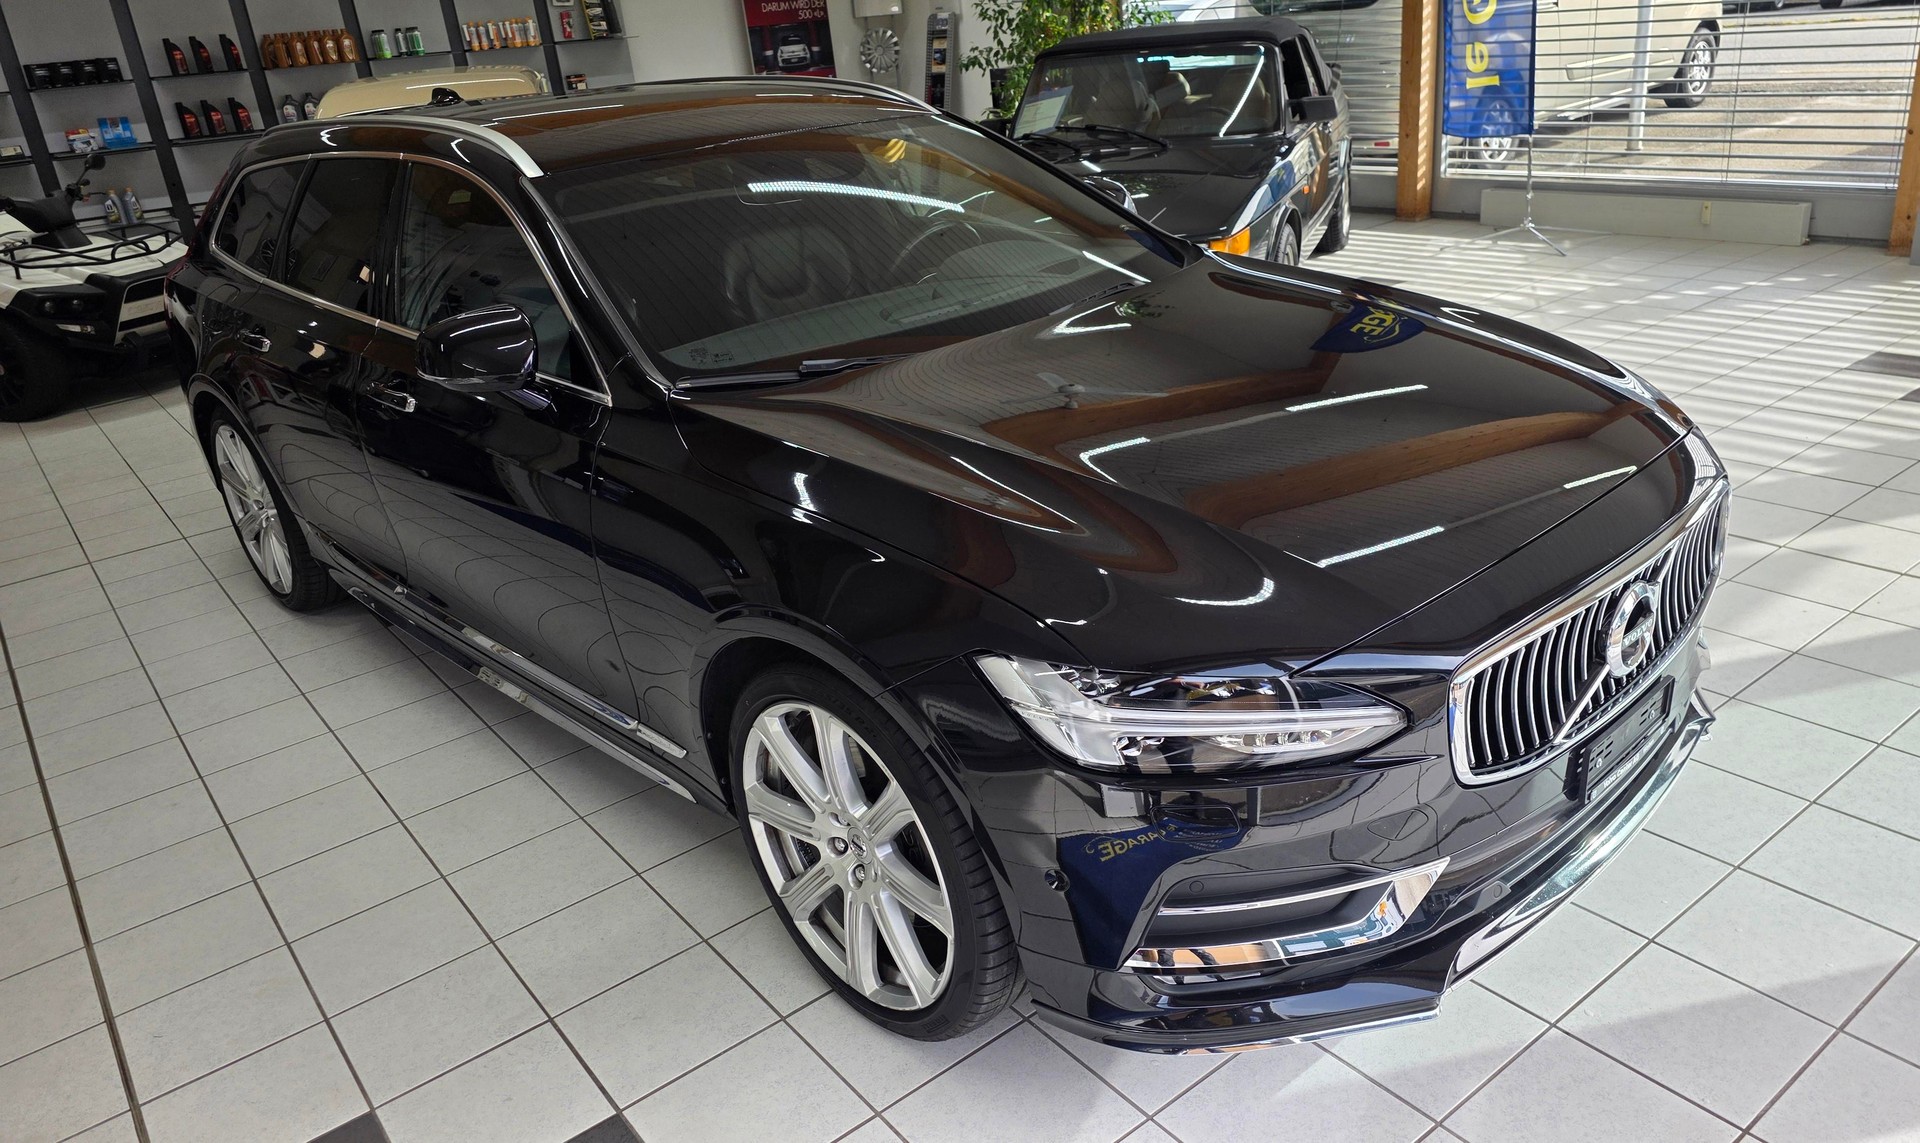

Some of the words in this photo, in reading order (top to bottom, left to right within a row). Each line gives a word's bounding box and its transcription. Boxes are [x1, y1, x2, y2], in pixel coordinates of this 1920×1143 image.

[761, 1, 790, 13] DARUM
[790, 0, 811, 9] WIRD
[811, 0, 825, 8] DER
[798, 9, 813, 20] 500
[1623, 619, 1653, 646] VOLVO
